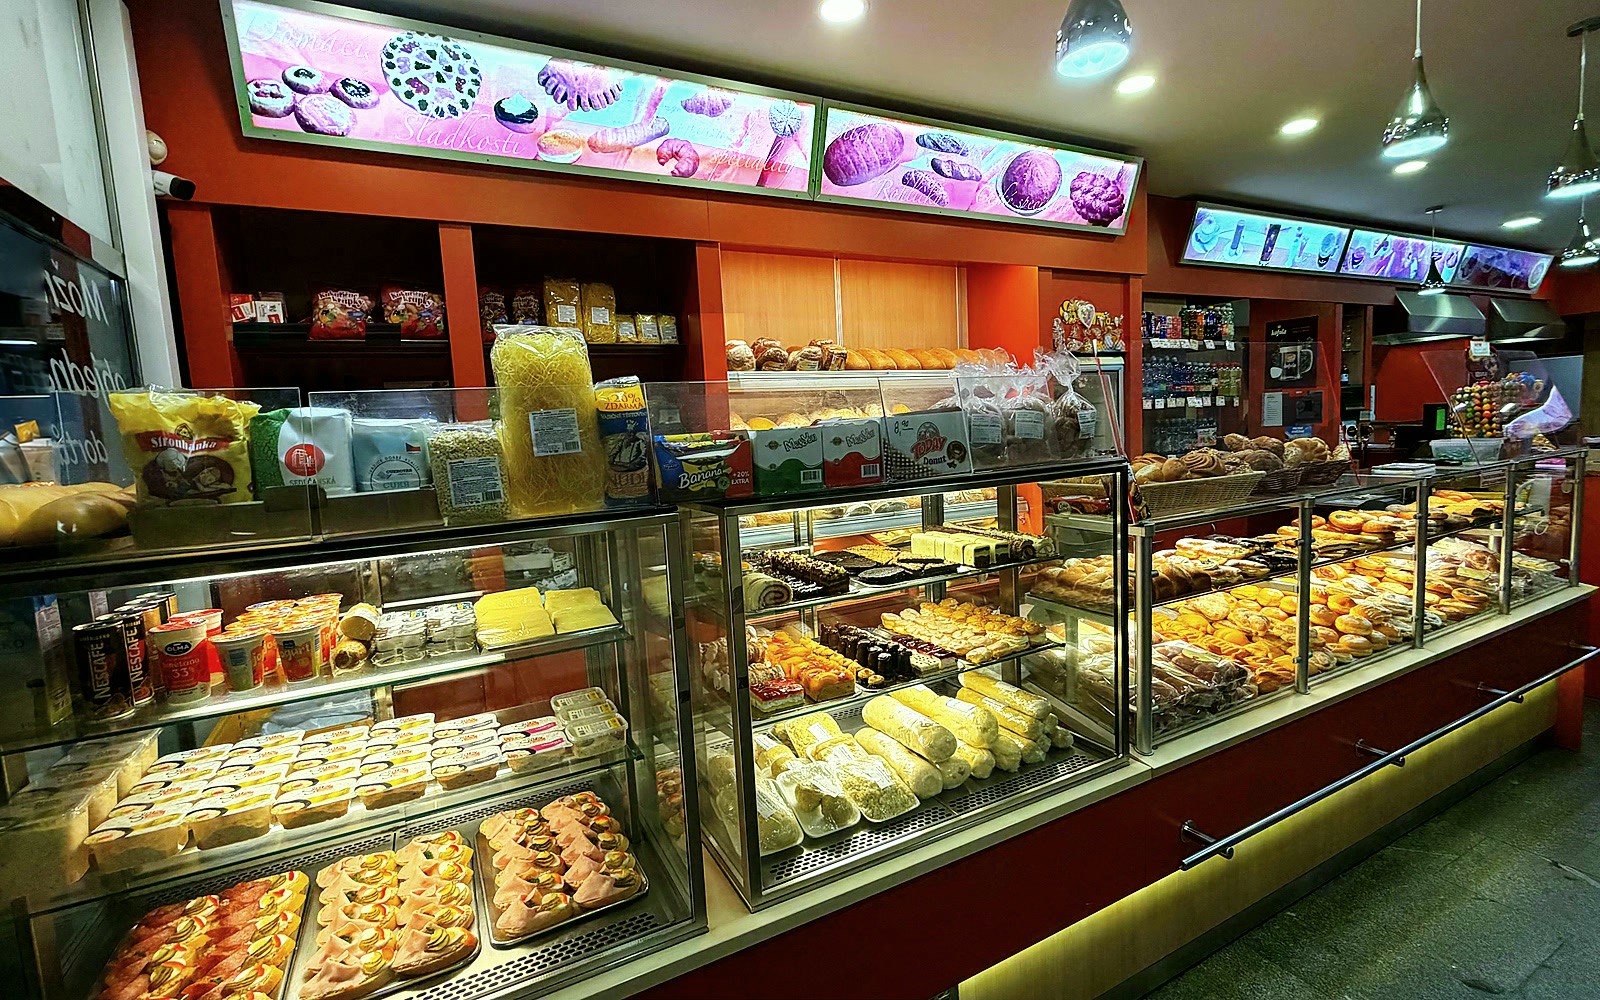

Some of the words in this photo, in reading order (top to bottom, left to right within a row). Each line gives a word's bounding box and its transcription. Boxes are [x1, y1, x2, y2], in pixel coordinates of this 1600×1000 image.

[394, 109, 526, 155] Sladkosti
[603, 402, 644, 410] ZDARMA
[911, 436, 948, 460] TODAY
[923, 455, 947, 465] Donut
[678, 468, 722, 489] Banana
[166, 644, 190, 652] OLMA
[279, 641, 311, 660] ogurt
